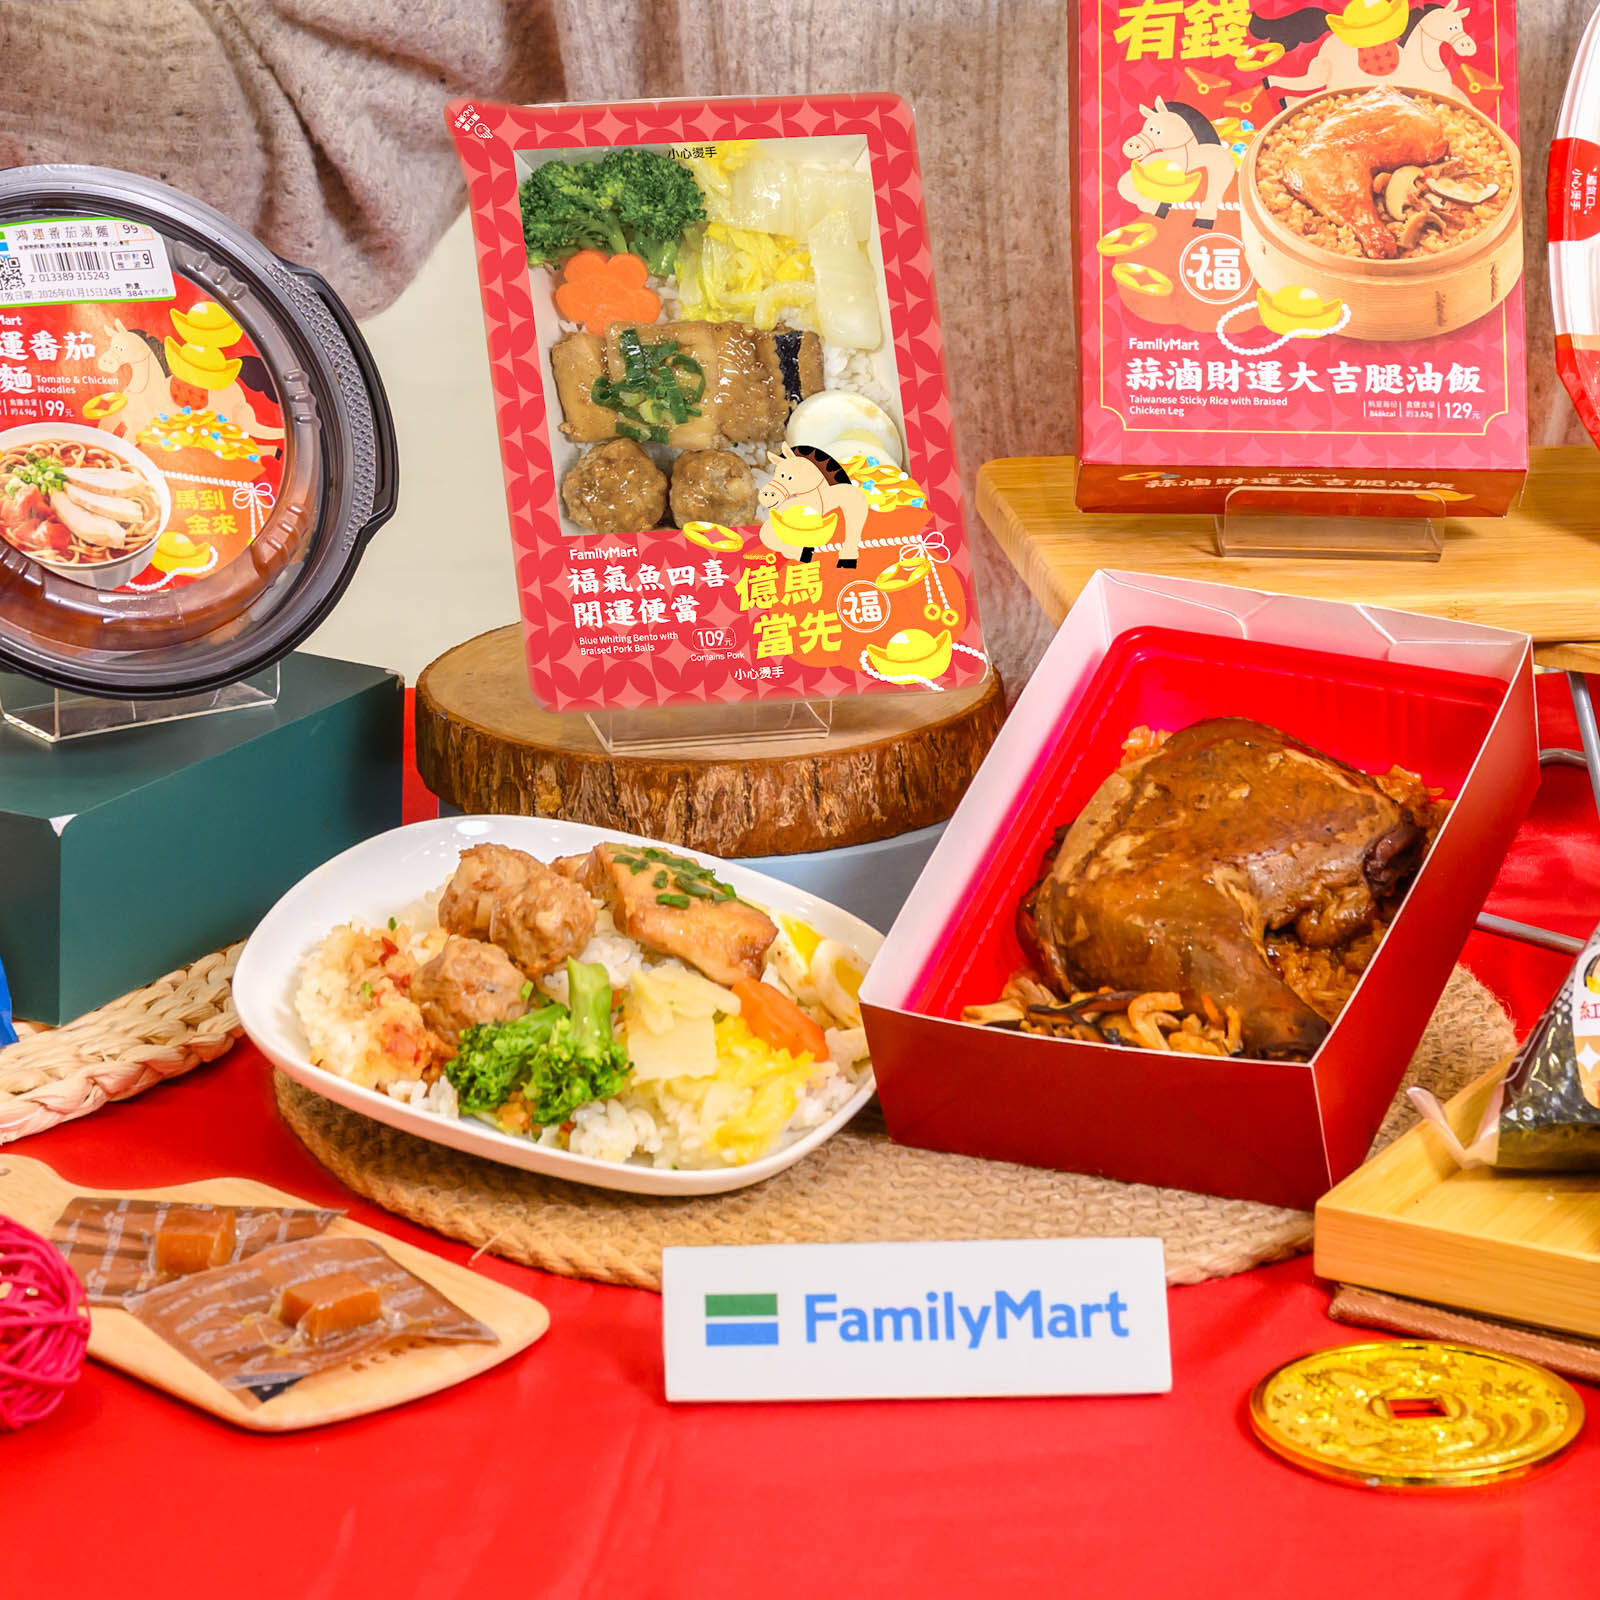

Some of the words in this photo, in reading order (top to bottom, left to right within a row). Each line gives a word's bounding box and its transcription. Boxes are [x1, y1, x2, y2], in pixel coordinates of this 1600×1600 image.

[666, 145, 718, 161] 小心燙手
[122, 223, 139, 235] 99
[38, 271, 74, 283] 013389
[76, 270, 110, 281] 315243
[1186, 246, 1242, 293] 福
[1128, 337, 1200, 352] FamilyMart
[35, 375, 71, 385] Tomato
[73, 376, 80, 385] &
[81, 375, 119, 386] Chicken
[1125, 357, 1486, 395] 蒜滷財運大吉腿油飯
[37, 385, 76, 394] Noodles
[1129, 393, 1177, 406] Taiwanese
[1178, 394, 1208, 407] Sticky
[1209, 395, 1228, 406] Rice
[1230, 395, 1251, 406] with
[1253, 395, 1288, 407] Braised
[1128, 404, 1166, 416] Chicken
[1168, 405, 1185, 418] Leg
[175, 488, 227, 512] 馬到
[185, 512, 239, 536] 金來
[569, 546, 638, 561] FamilyMart
[566, 558, 731, 596] 福氣魚四喜
[734, 560, 823, 613] 億馬
[572, 595, 700, 630] 開運便當
[842, 589, 883, 624] 福
[578, 635, 597, 647] Blue
[597, 633, 632, 647] Whiting
[632, 632, 659, 645] Bento
[659, 630, 679, 642] with
[752, 610, 843, 660] 當先
[580, 644, 612, 657] Braised
[612, 643, 633, 655] Pork
[634, 641, 656, 654] Balls
[690, 652, 724, 663] Contains
[725, 650, 745, 661] Pork
[734, 665, 785, 682] 小心燙手
[1521, 1106, 1535, 1121] 3
[805, 1289, 1130, 1349] FamilyMart
